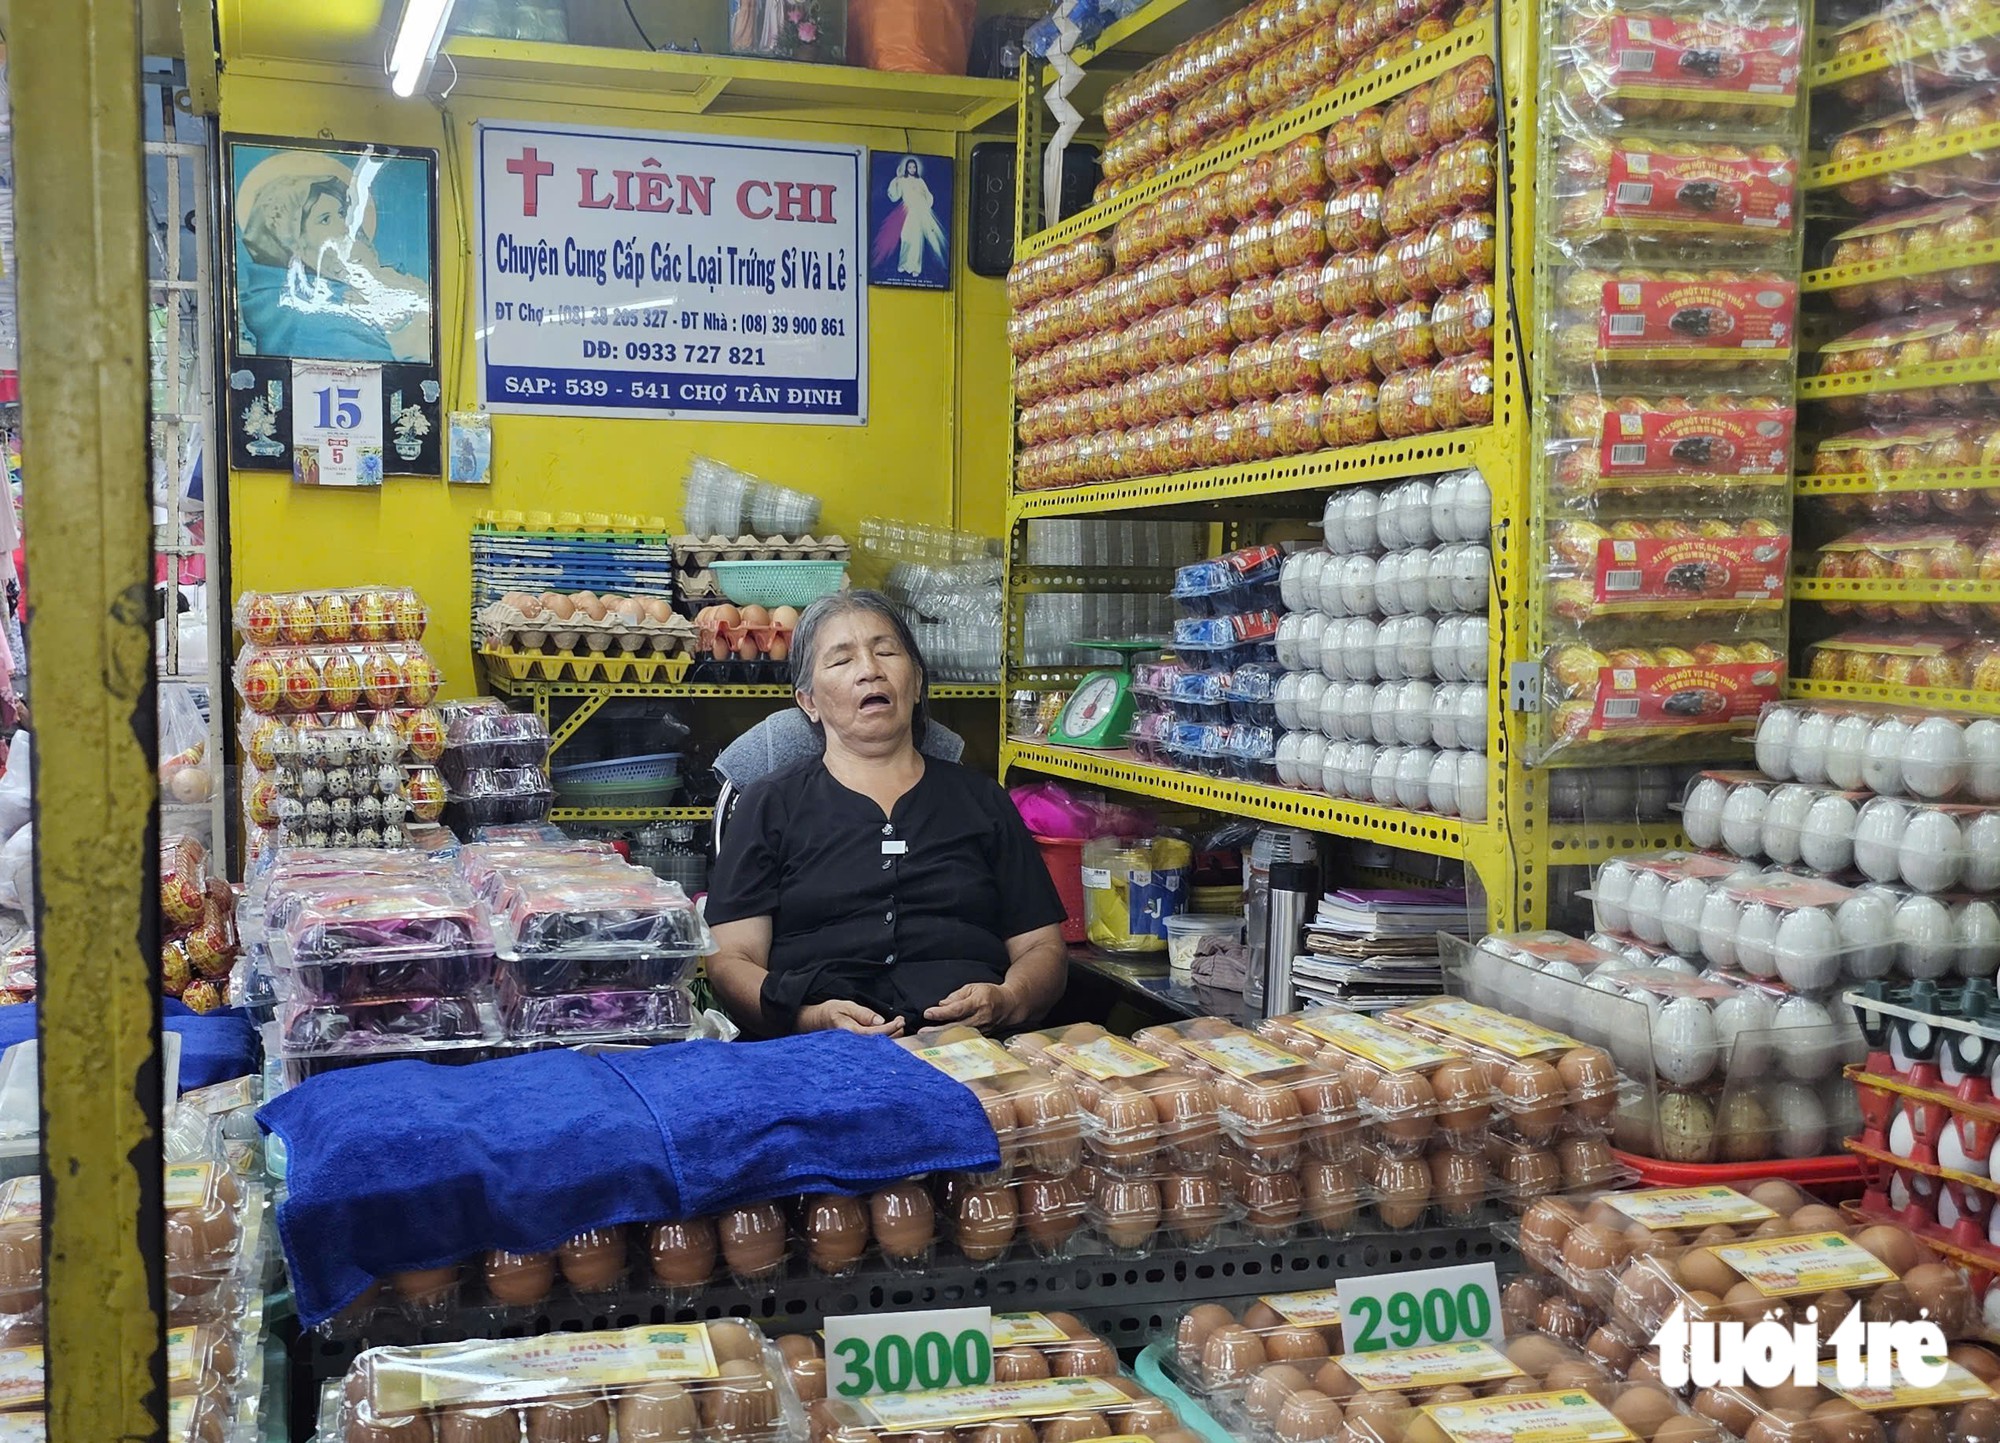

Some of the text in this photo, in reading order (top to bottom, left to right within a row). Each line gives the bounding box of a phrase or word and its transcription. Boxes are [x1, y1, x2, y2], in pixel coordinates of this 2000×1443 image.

[577, 157, 837, 224] LIÊN CHI
[496, 233, 847, 295] Chuyên Cung Cấp Các Loại Trứng Sỉ Và Lẻ
[495, 302, 514, 321] ĐT
[518, 303, 545, 326] Chợ
[642, 310, 669, 328] 327
[681, 311, 699, 330] ĐT
[703, 312, 728, 331] Nhà
[741, 314, 767, 335] (08)
[772, 315, 789, 335] 39
[793, 316, 817, 335] 900
[821, 318, 845, 336] 861
[583, 340, 766, 366] DĐ: 0933 727 821
[313, 386, 362, 429] 15
[505, 376, 557, 397] SẠP:
[565, 379, 609, 397] 539
[630, 382, 671, 399] 541
[679, 383, 728, 405] CHỢ
[734, 383, 780, 403] TÂN
[787, 388, 843, 408] ĐỊNH
[332, 448, 343, 464] 5
[1349, 1283, 1492, 1353] 2900
[833, 1329, 992, 1396] 3000
